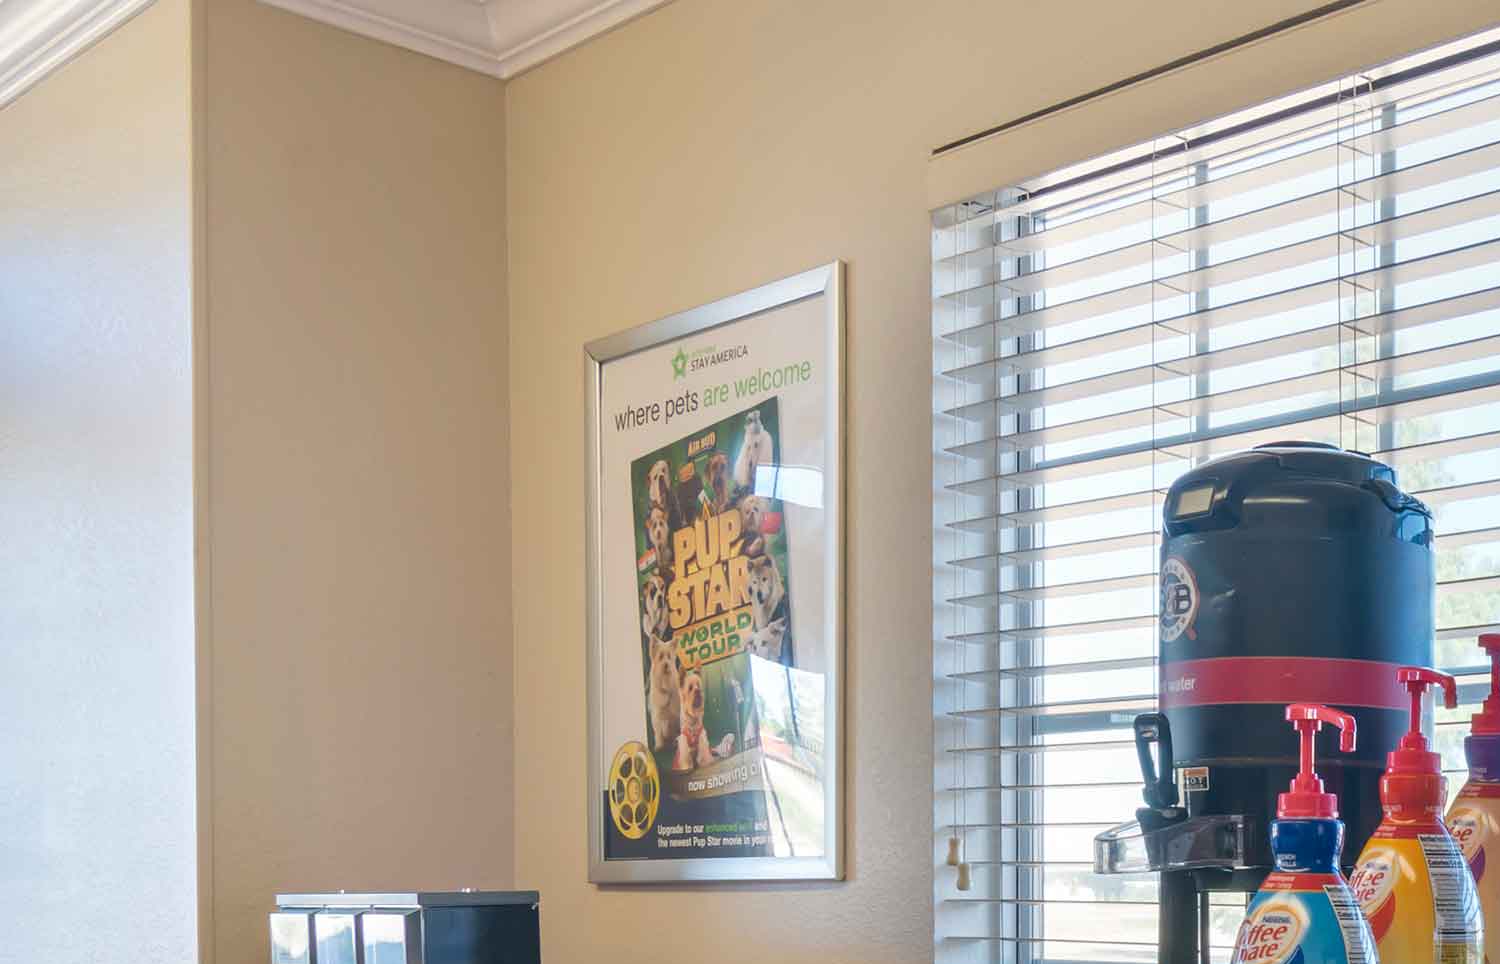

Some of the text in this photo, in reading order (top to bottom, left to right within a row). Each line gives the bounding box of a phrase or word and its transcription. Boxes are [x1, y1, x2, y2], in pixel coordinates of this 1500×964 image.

[615, 360, 812, 432] where pets are welcome
[673, 509, 742, 578] PUP
[668, 556, 752, 629] STAR
[679, 611, 752, 648] WORLD
[685, 633, 741, 663] TOUR
[688, 780, 706, 792] now
[707, 766, 748, 789] showing
[657, 823, 684, 836] Upgrade
[685, 823, 692, 834] to
[693, 824, 705, 834] our
[657, 838, 668, 849] the
[669, 837, 692, 848] newest
[693, 836, 706, 848] Pup
[707, 835, 722, 847] Star
[723, 835, 743, 846] movie
